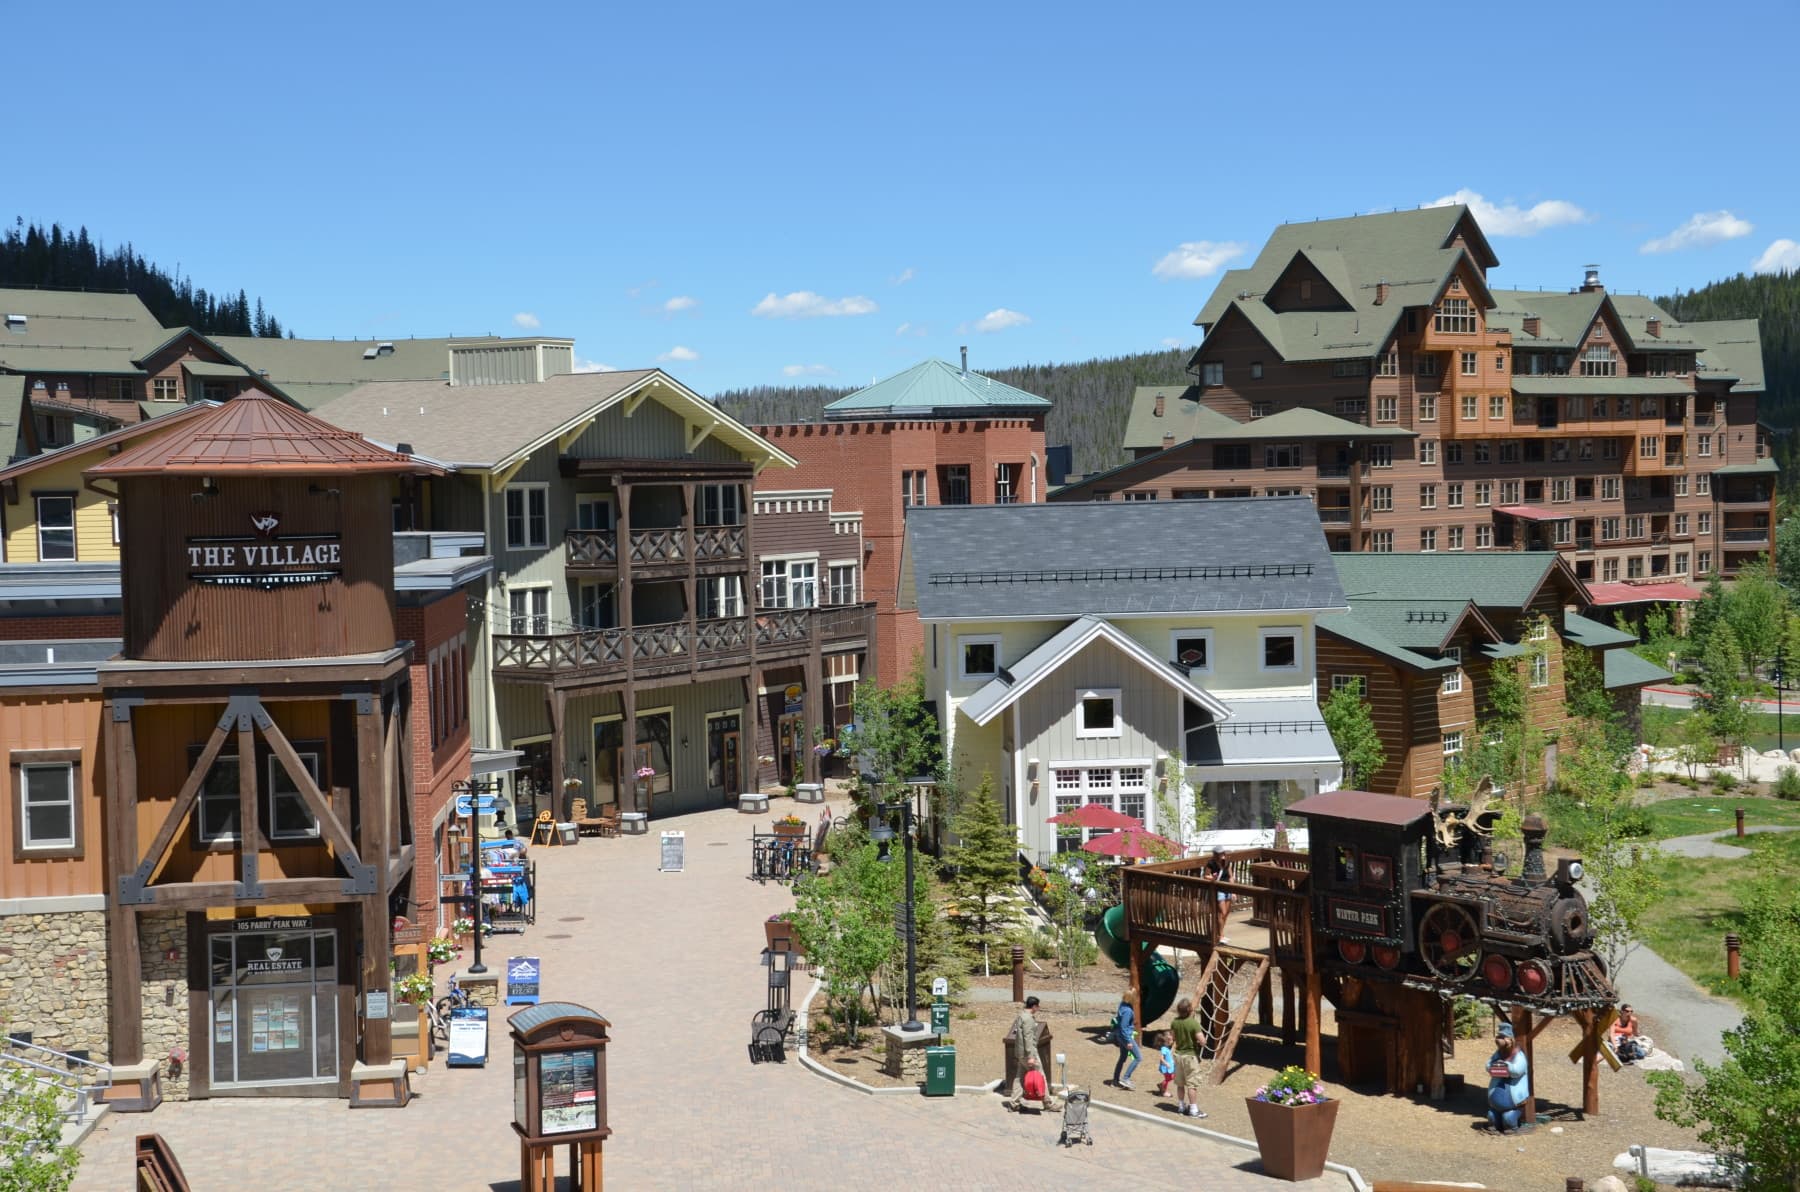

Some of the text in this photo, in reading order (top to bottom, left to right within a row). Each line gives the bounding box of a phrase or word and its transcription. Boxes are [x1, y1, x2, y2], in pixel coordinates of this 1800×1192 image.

[188, 544, 341, 567] THE VILLAGE
[283, 575, 317, 583] RESORT
[1336, 908, 1378, 925] WINTER PARK
[238, 922, 249, 930] 105
[273, 920, 290, 929] PEAK
[291, 919, 308, 928] WAY
[247, 961, 303, 971] REAL ESTATE
